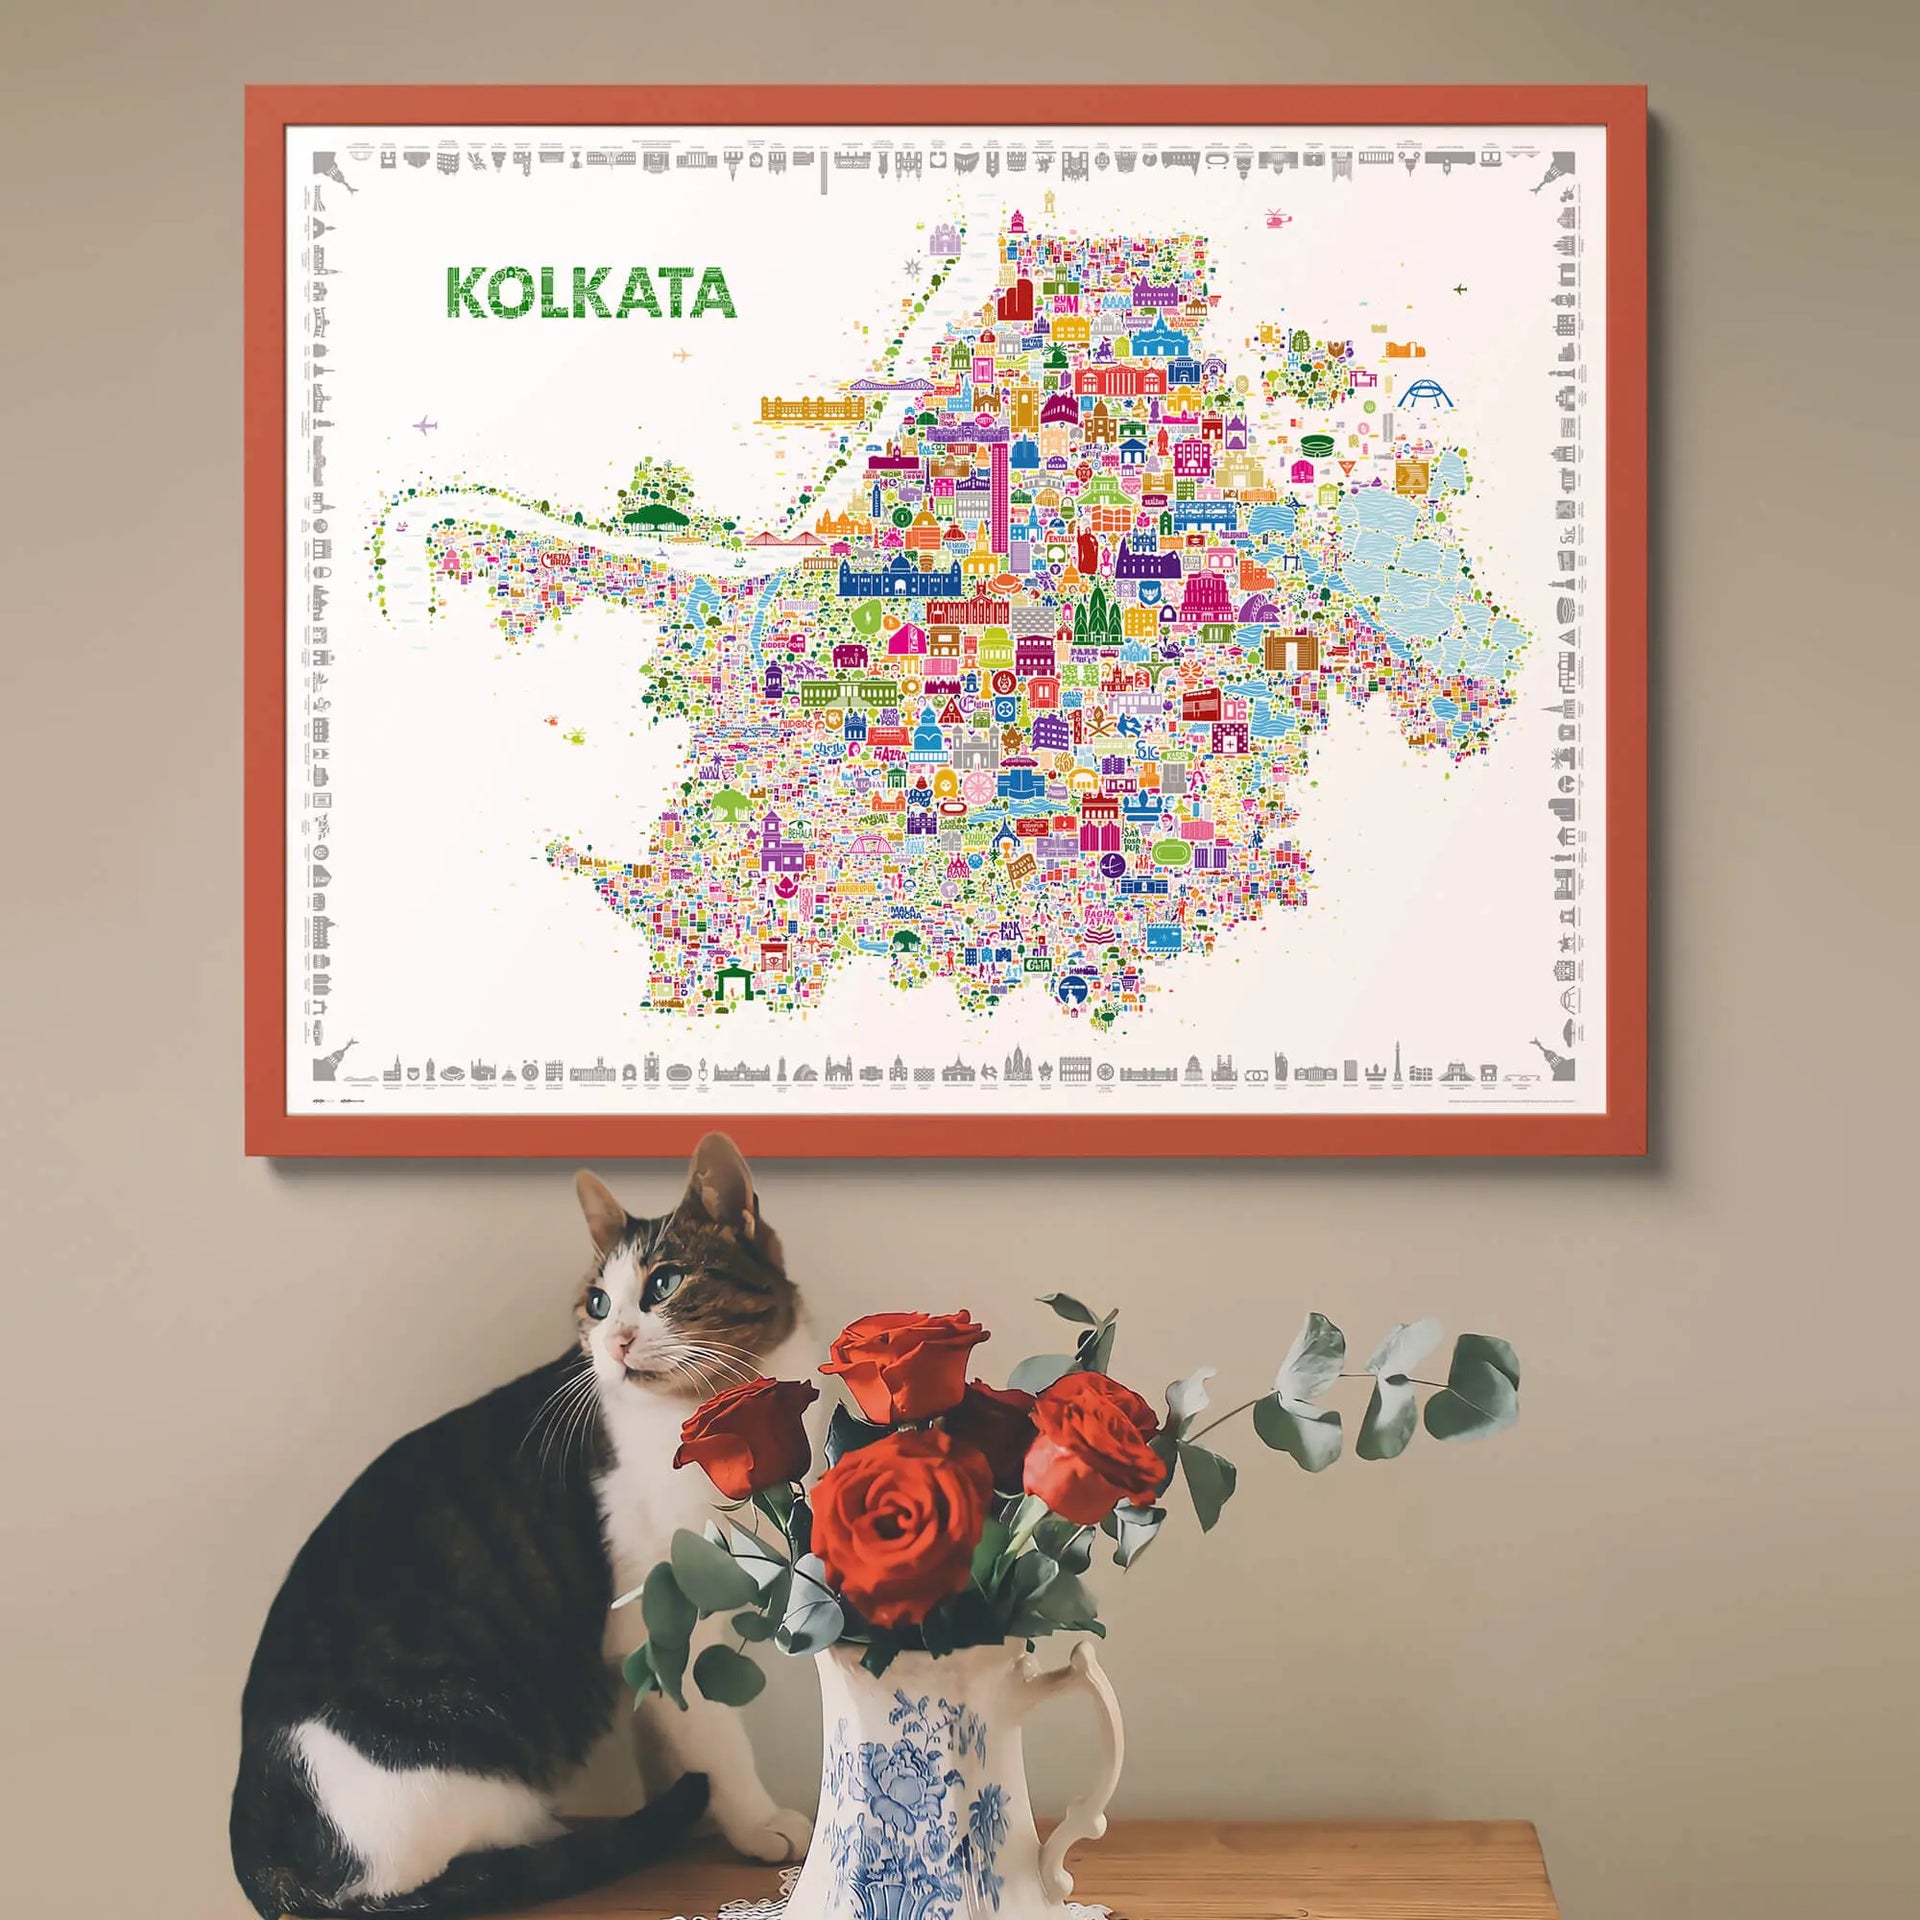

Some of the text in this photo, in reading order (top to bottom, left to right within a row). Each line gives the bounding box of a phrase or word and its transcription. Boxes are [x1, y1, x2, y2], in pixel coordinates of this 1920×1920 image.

[447, 266, 737, 319] KOLKATA
[1049, 535, 1076, 543] ENTALLY
[1070, 648, 1099, 656] PARK
[843, 653, 858, 665] TAJ
[1071, 655, 1097, 664] CIRCUS
[959, 694, 990, 713] Elgin
[779, 719, 813, 729] ALIPORE
[873, 746, 907, 762] HAZRA
[843, 780, 885, 788] KALIGHAT
[788, 828, 813, 839] BEHALA
[1124, 827, 1140, 838] SAN
[1124, 844, 1139, 854] PUR
[947, 866, 970, 875] RANI
[1084, 909, 1115, 919] BAGHA
[1000, 921, 1019, 930] NAK
[1084, 917, 1113, 926] JATIN
